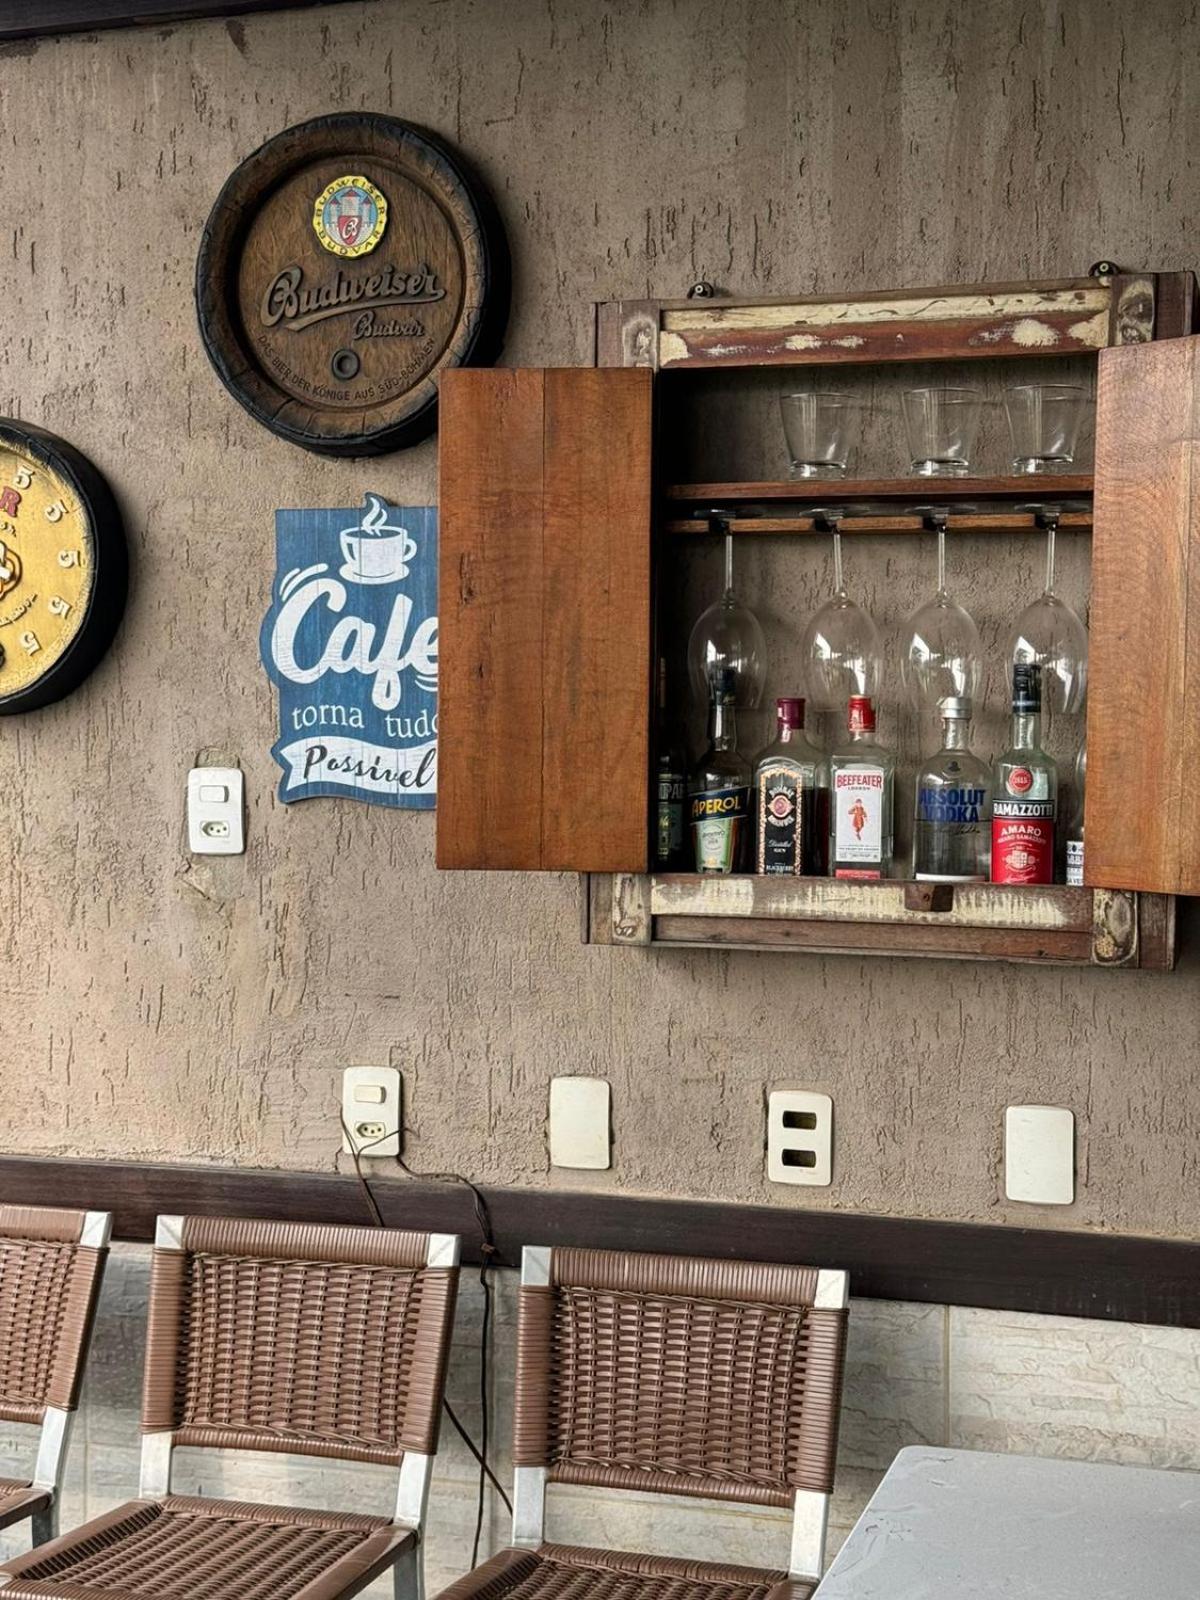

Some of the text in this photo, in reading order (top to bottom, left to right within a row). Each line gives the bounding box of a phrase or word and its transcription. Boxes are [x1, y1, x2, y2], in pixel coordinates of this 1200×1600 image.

[260, 264, 446, 330] Budweiser
[353, 310, 426, 341] Budvar
[271, 356, 292, 379] BIER
[291, 374, 312, 392] DER
[354, 386, 375, 400] AUS
[13, 465, 35, 490] 5
[292, 705, 364, 729] torna
[837, 774, 882, 789] BEEFEATER
[691, 796, 741, 816] APEROL
[920, 788, 985, 806] ABSOLUT
[926, 805, 979, 823] VODKA
[1001, 825, 1042, 837] AMARO
